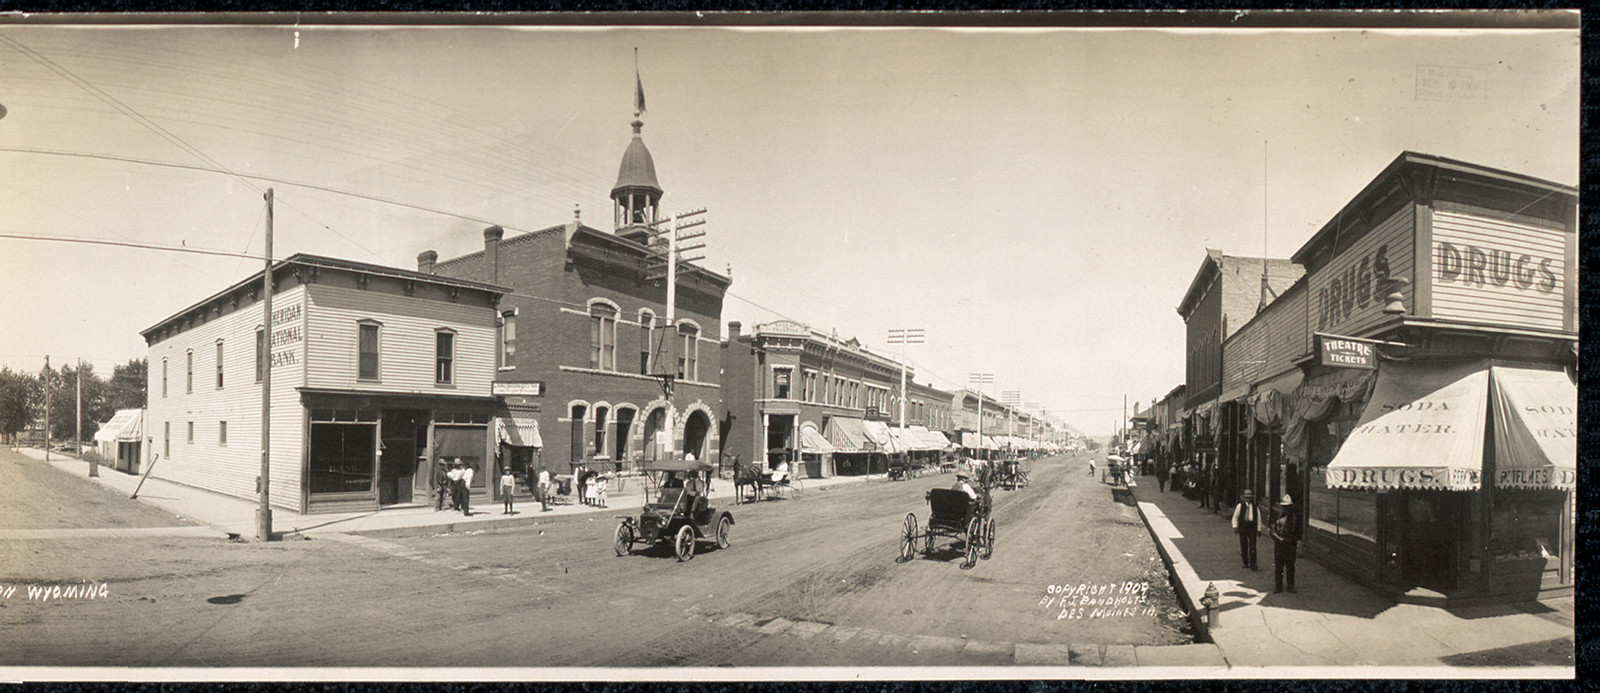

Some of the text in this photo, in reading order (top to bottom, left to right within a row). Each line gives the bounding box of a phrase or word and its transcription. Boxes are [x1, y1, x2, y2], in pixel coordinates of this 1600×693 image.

[1436, 241, 1557, 295] DRUGS
[1316, 243, 1391, 331] DRUGS
[272, 303, 301, 326] HERIDAN
[272, 325, 303, 347] ATIONAL
[1324, 340, 1372, 356] THEATRE
[1330, 353, 1367, 365] TICKETS
[1380, 400, 1450, 412] SODA
[1342, 469, 1440, 485] DRUGS.
